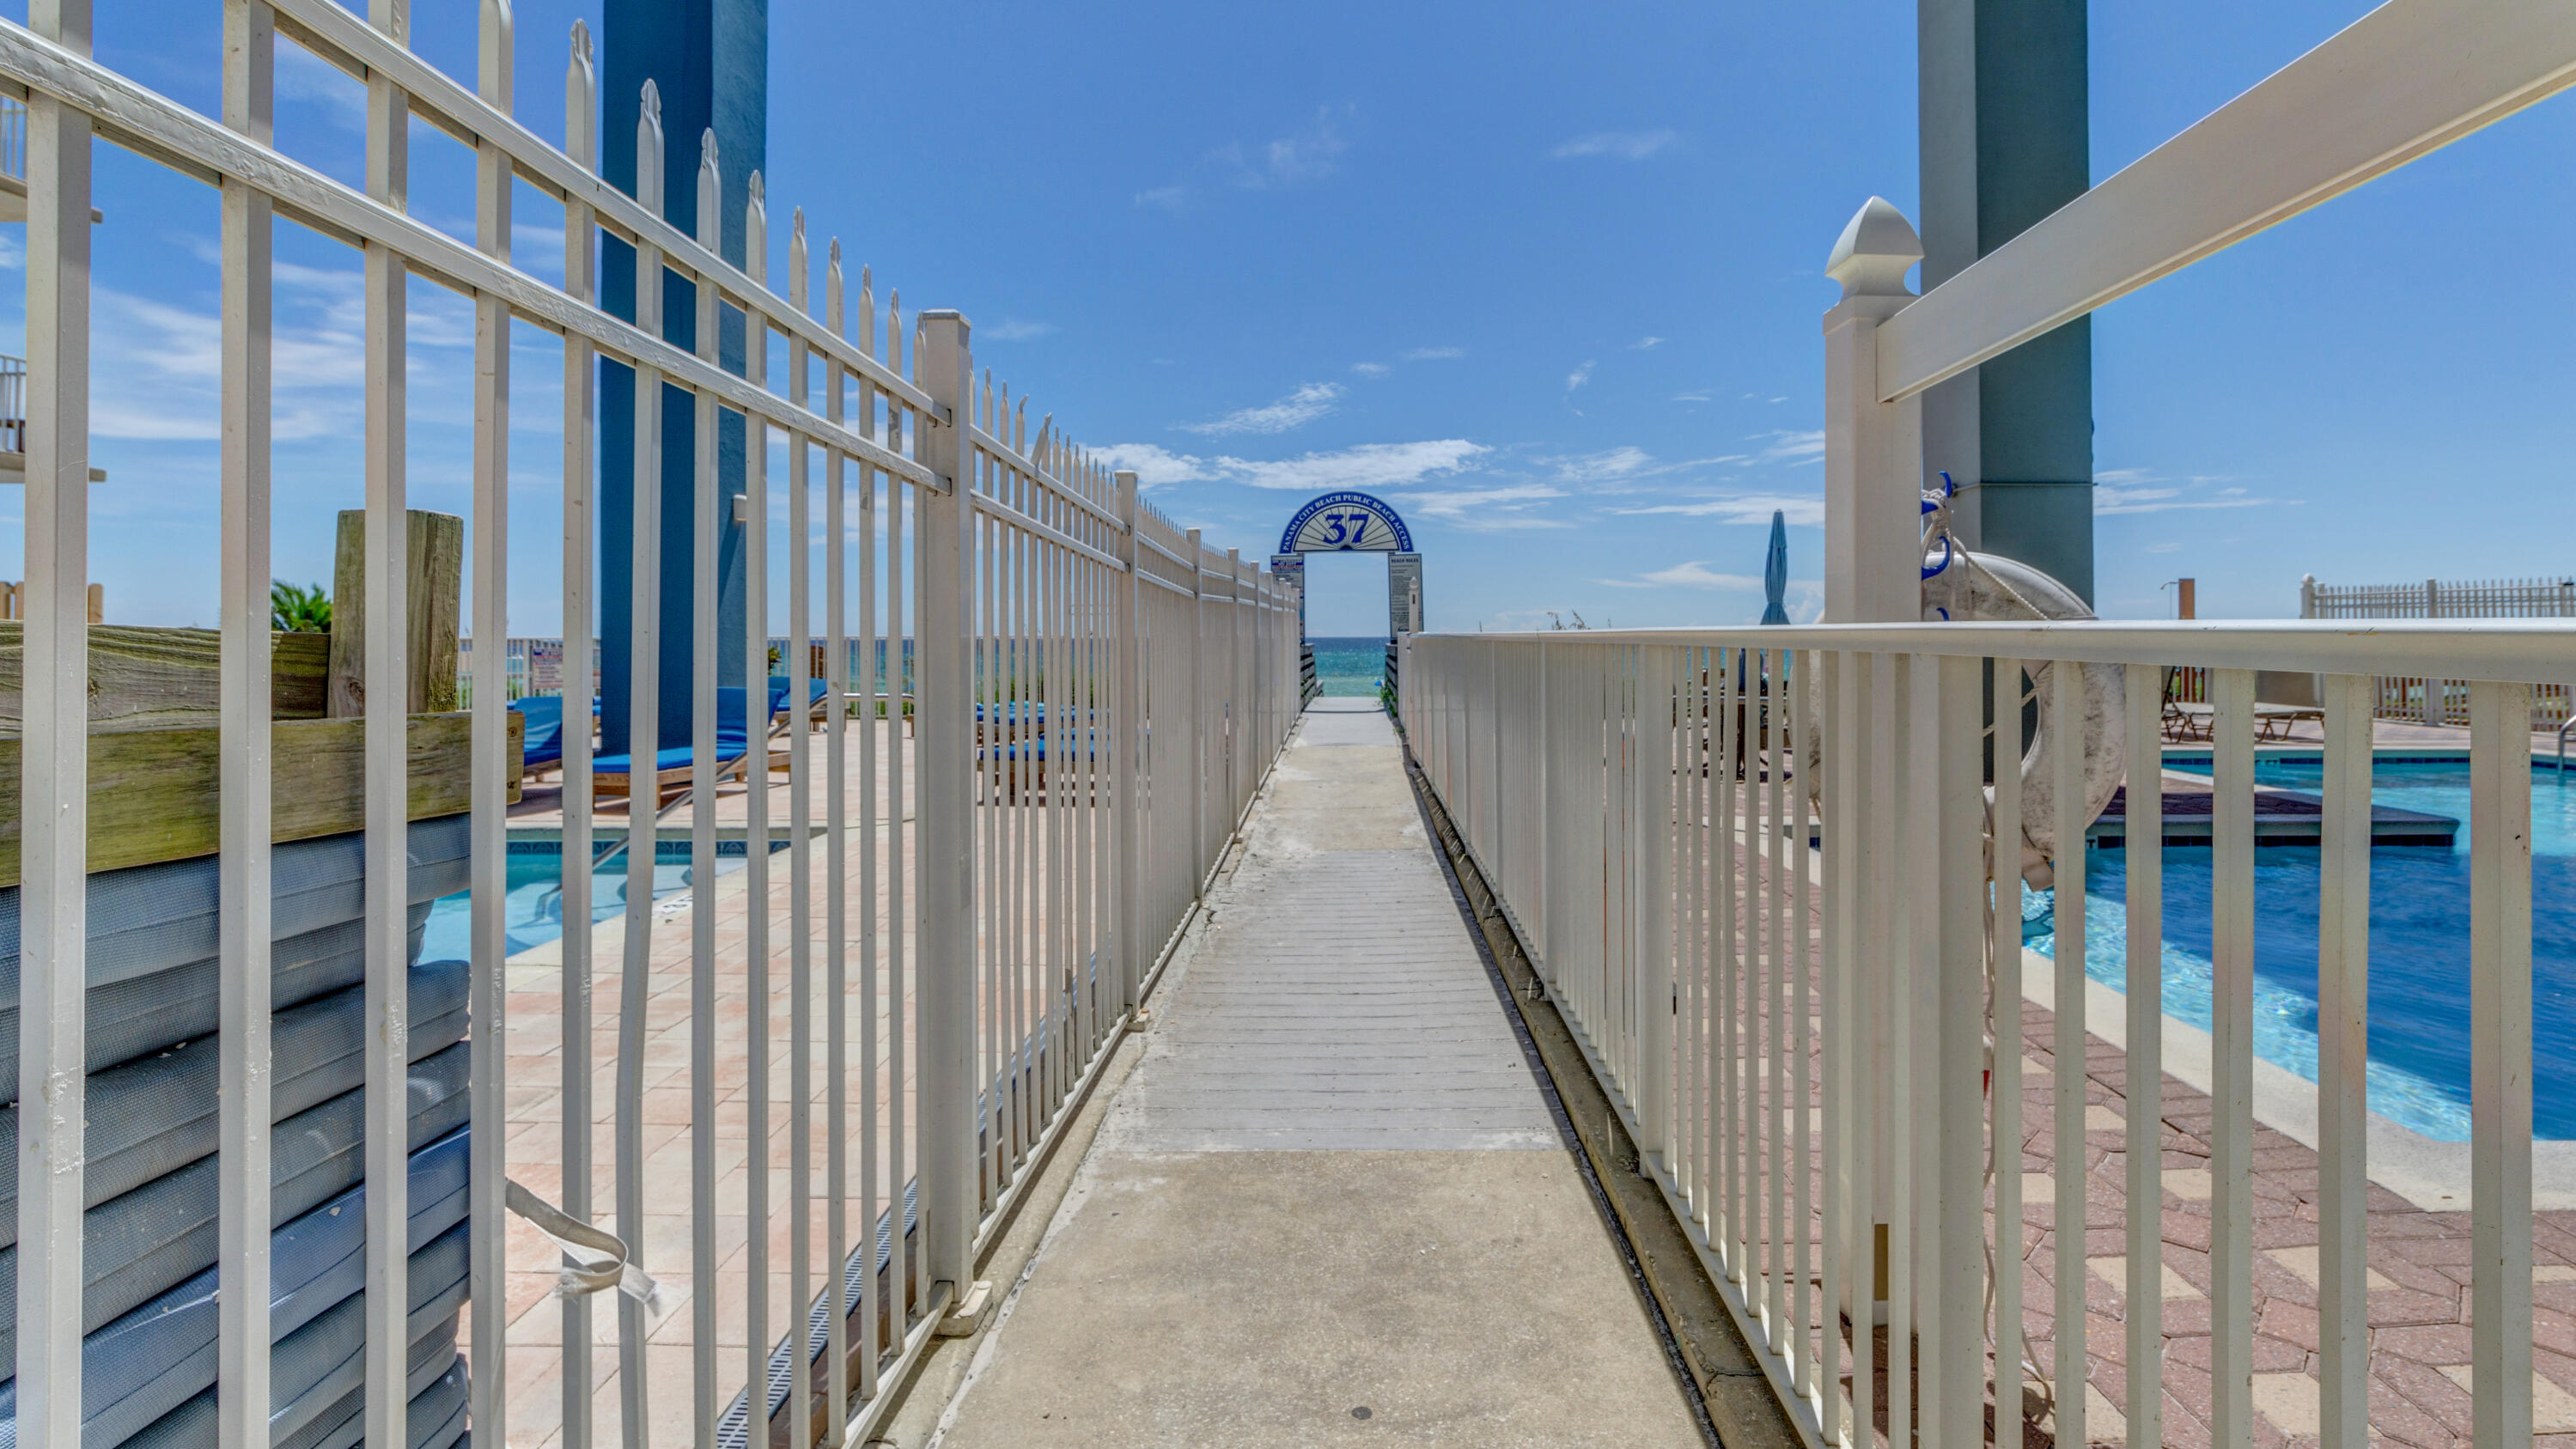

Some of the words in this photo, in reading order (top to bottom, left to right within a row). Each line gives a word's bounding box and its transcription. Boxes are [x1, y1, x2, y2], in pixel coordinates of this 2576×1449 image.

[1282, 521, 1300, 551] PANAMA
[1299, 504, 1315, 521] CITY
[1314, 495, 1342, 508] BEACH
[1343, 494, 1373, 506] PUBLIC
[1372, 501, 1396, 522] BEACH
[1393, 521, 1410, 550] ACCESS
[1323, 514, 1369, 544] 37
